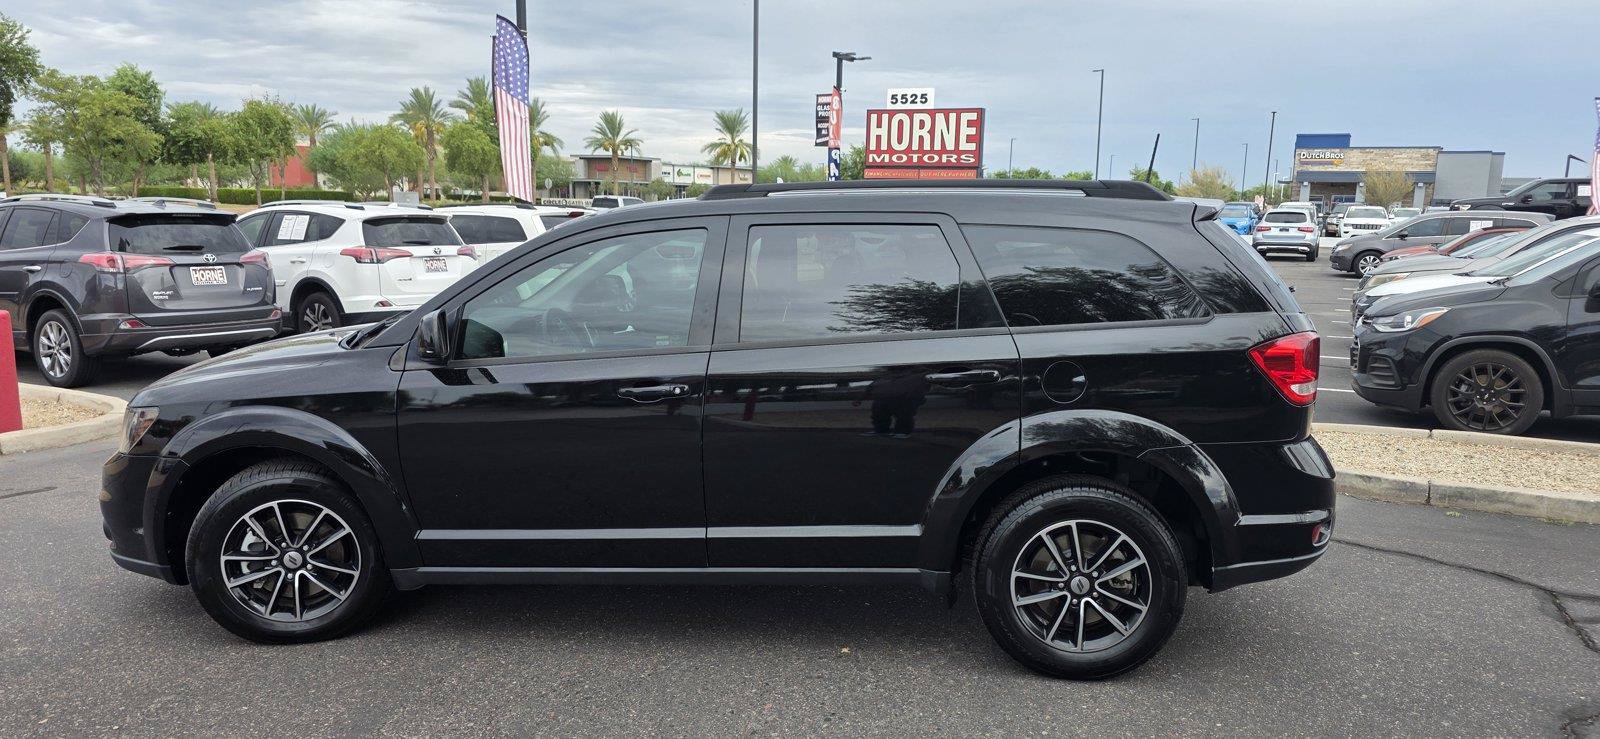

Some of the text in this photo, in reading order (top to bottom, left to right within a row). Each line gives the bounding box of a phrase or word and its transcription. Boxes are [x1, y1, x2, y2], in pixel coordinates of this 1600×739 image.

[890, 93, 929, 105] 5525
[869, 112, 978, 151] HORNE
[868, 153, 976, 163] MOTORS
[1300, 151, 1345, 159] DUTCH BROS
[192, 269, 224, 281] HORNE
